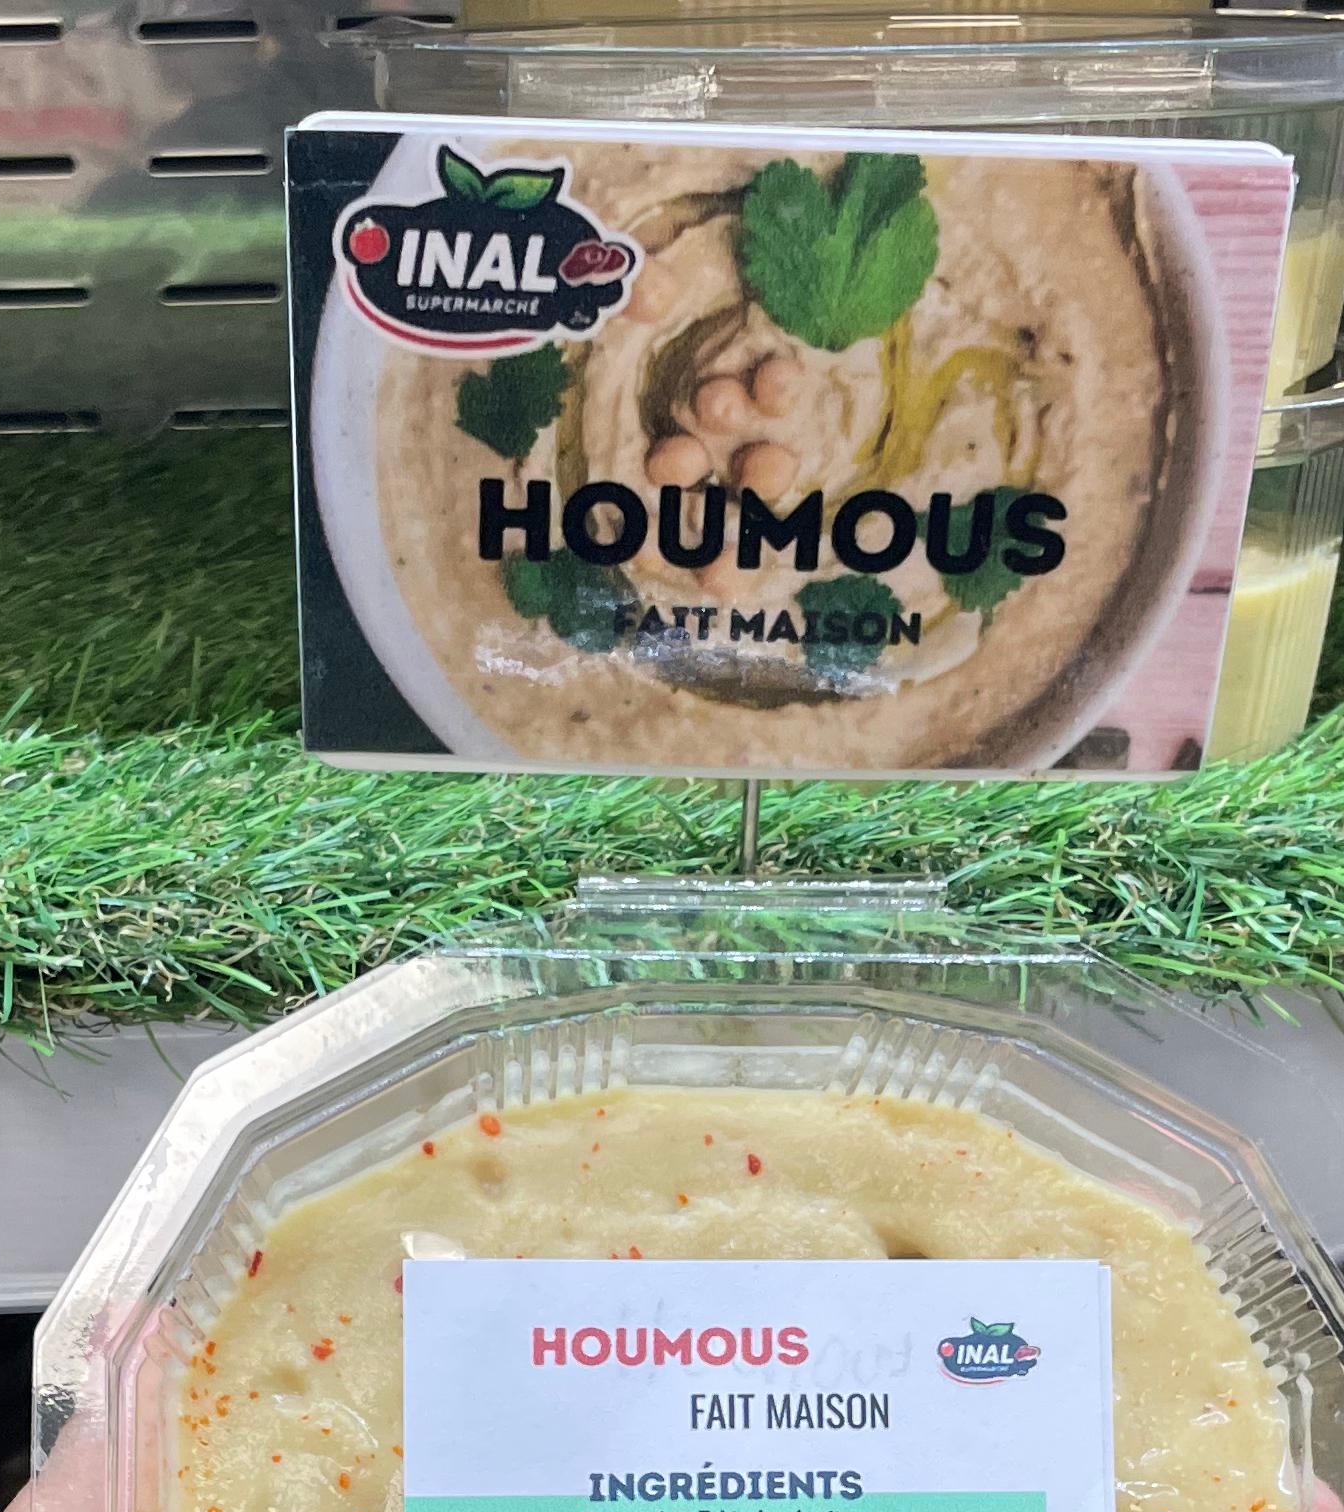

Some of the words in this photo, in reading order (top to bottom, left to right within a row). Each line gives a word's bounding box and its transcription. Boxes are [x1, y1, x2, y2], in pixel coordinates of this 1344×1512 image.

[396, 230, 559, 294] INAL
[405, 294, 540, 317] SUPERMARCHÉ
[477, 478, 1068, 577] HOUMOUS
[613, 608, 719, 644] FAIT
[729, 608, 922, 648] MAISON
[531, 1326, 809, 1367] HOUMOUS
[956, 1343, 1015, 1365] INAL
[690, 1394, 755, 1430] FAIT
[766, 1393, 890, 1430] MAISON
[588, 1462, 864, 1502] INGRÉDIENTS
